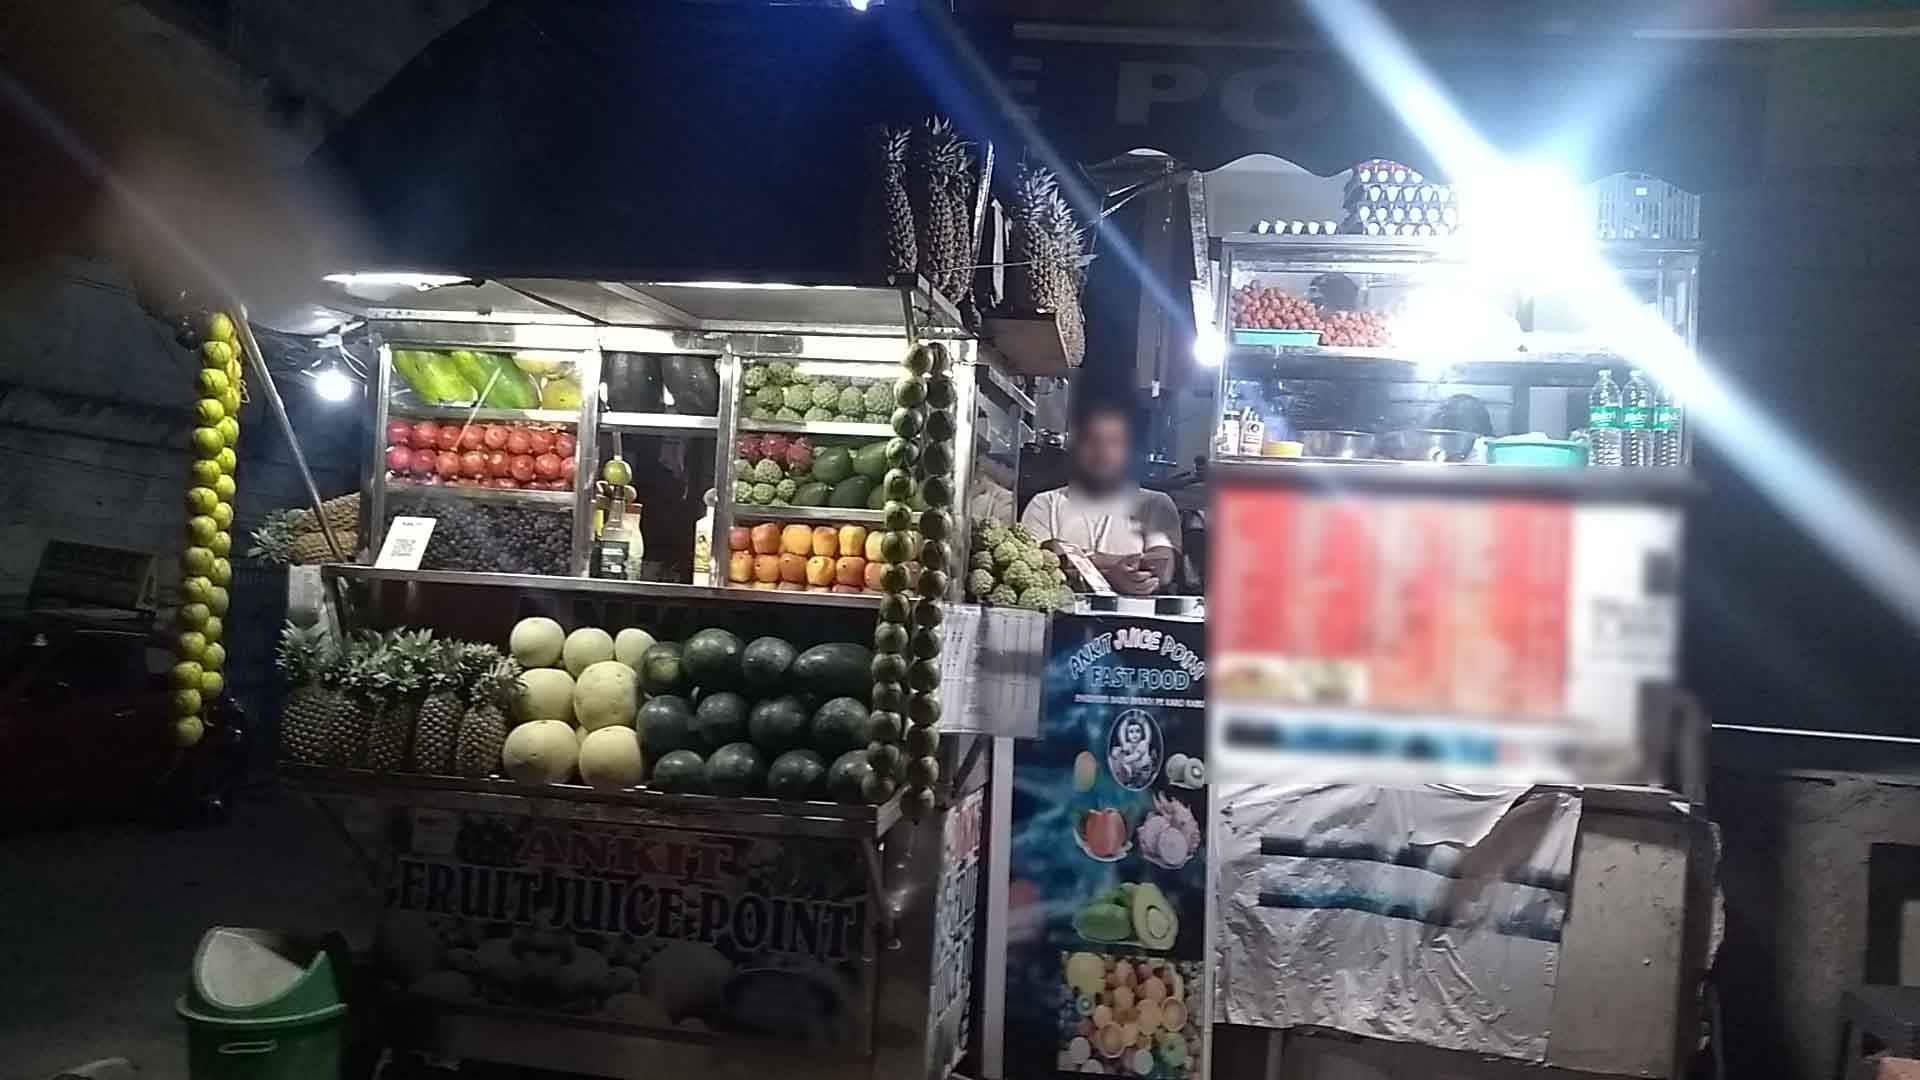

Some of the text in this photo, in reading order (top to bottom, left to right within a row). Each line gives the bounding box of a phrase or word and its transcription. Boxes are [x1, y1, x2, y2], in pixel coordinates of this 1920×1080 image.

[1070, 632, 1112, 680] ANKIT
[1113, 627, 1162, 650] JUICE
[1090, 666, 1190, 690] FAST FOOD
[513, 826, 738, 882] ANKIT
[398, 857, 857, 961] FRUIT JUICE POINT
